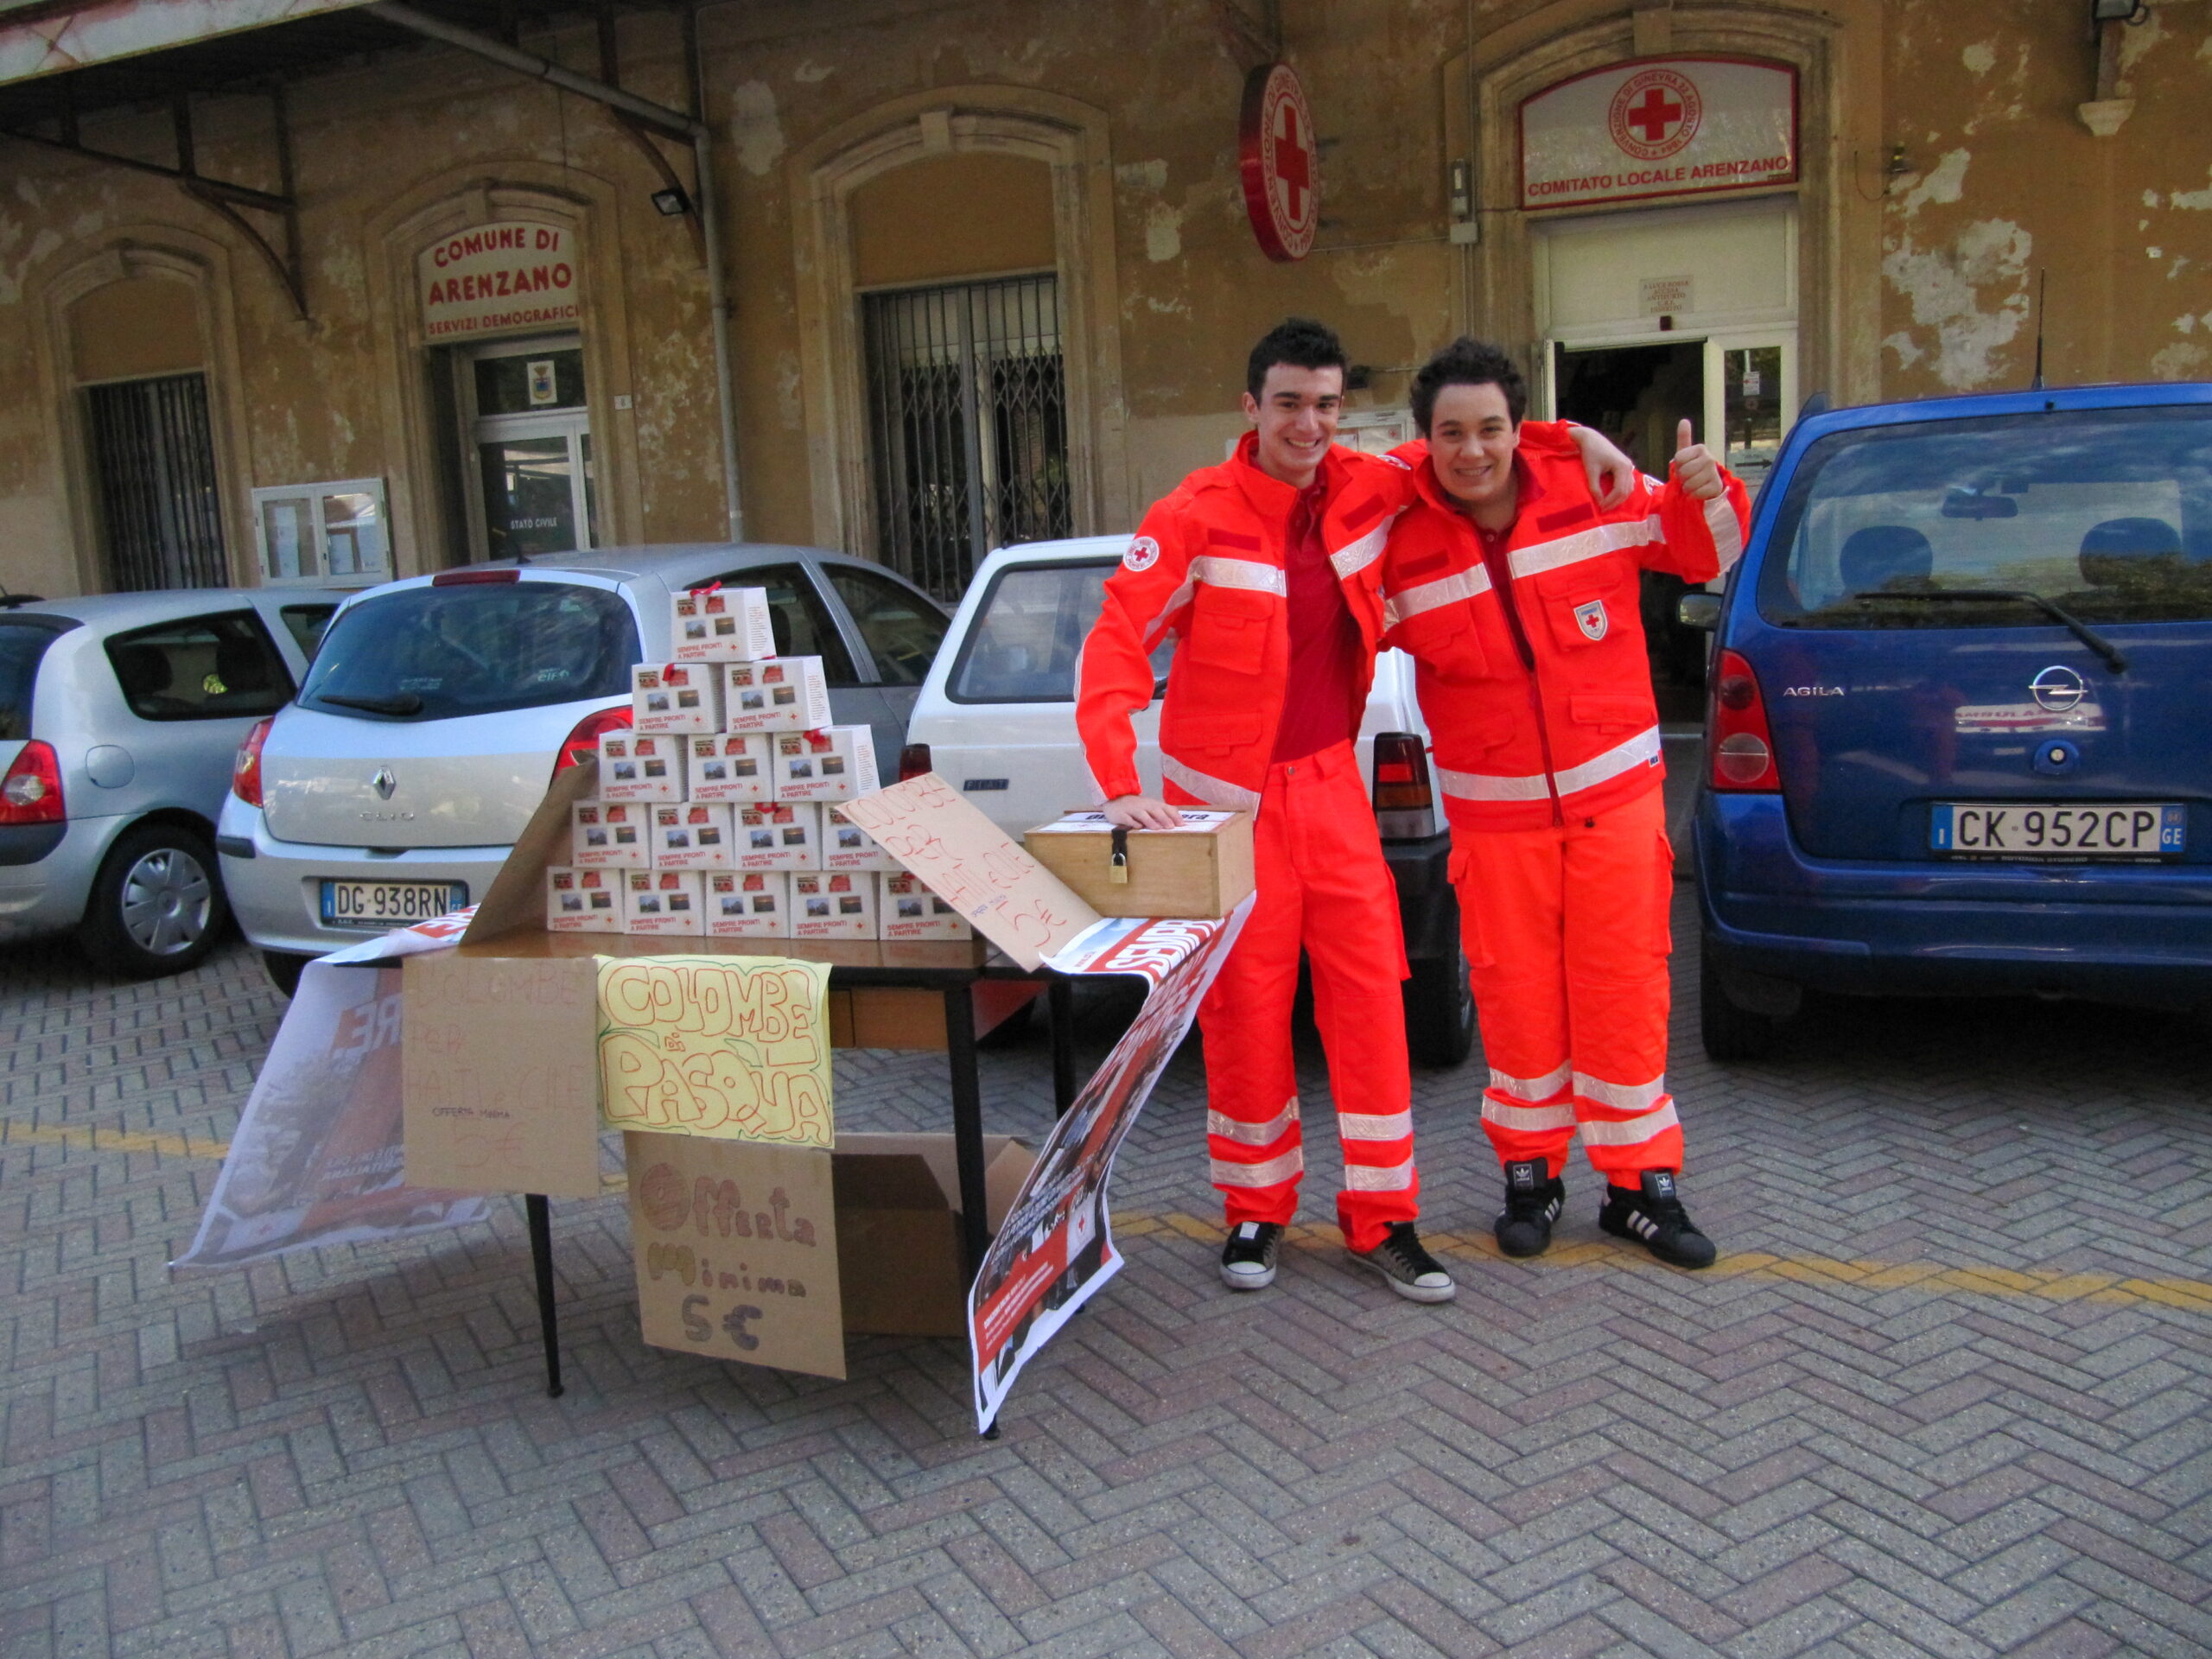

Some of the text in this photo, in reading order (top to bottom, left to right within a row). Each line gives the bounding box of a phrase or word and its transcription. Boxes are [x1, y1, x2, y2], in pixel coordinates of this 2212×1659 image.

[1528, 156, 1789, 197] COMITATO LOCALE ARENZANO
[434, 227, 559, 268] COMUNE DI
[429, 262, 572, 306] ARENZANO
[429, 304, 580, 335] SERVIZI DEMOGRAFICI
[510, 517, 557, 530] STATO CIVILE
[1783, 686, 1845, 696] AGILA
[739, 721, 765, 729] PARTIRE
[787, 790, 812, 798] PARTIRE
[965, 780, 1007, 790] FIAT
[1959, 810, 2006, 847] CK
[2024, 810, 2155, 849] 952CP
[2162, 828, 2183, 845] GE
[338, 886, 364, 916] DG
[374, 887, 448, 918] 938RN
[887, 922, 913, 931] SEMPRE
[606, 965, 818, 1066] COLOMBE
[601, 1033, 832, 1147] PASQUA
